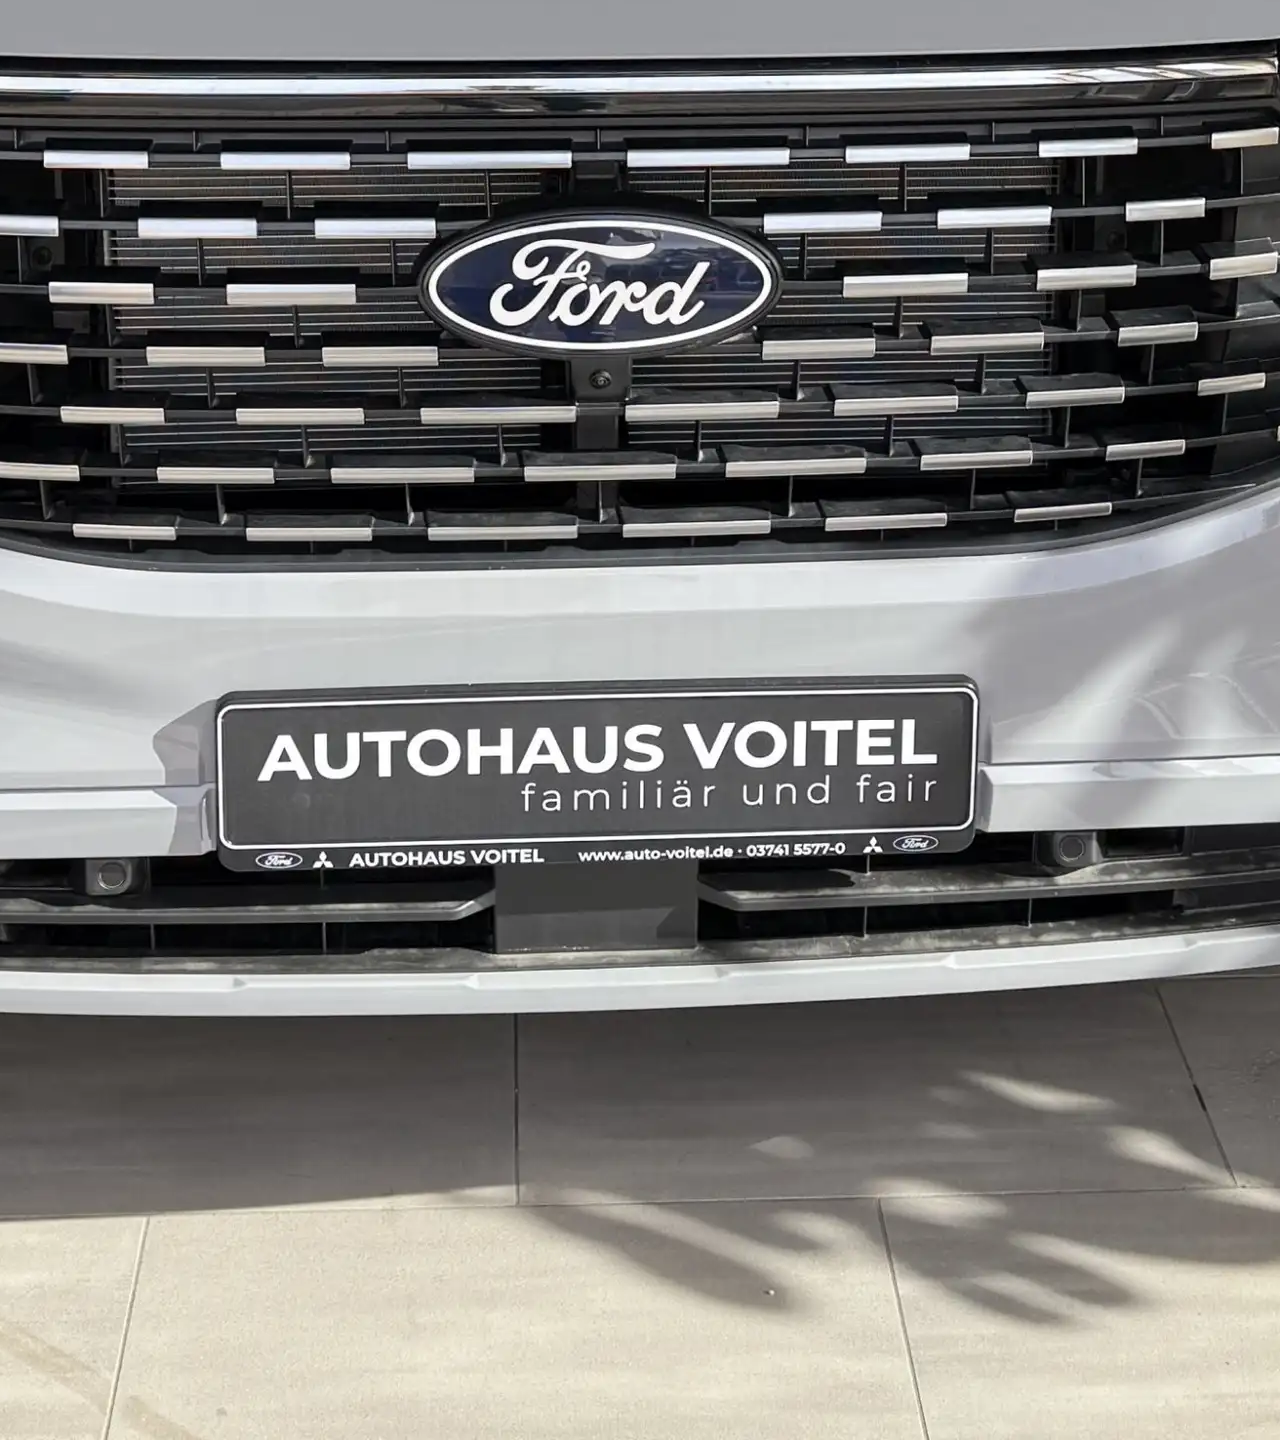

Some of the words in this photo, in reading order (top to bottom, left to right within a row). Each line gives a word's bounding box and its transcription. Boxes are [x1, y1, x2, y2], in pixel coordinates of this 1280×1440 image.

[489, 238, 710, 327] Ford
[257, 723, 664, 782] AUTOHAUS
[683, 718, 938, 769] VOITEL
[520, 779, 716, 812] familiär
[742, 774, 831, 806] und
[856, 772, 938, 803] fair
[348, 851, 466, 867] AUTOHAUS
[470, 848, 544, 864] VOITEL
[746, 844, 790, 857] 03741
[793, 842, 846, 856] 5577-0
